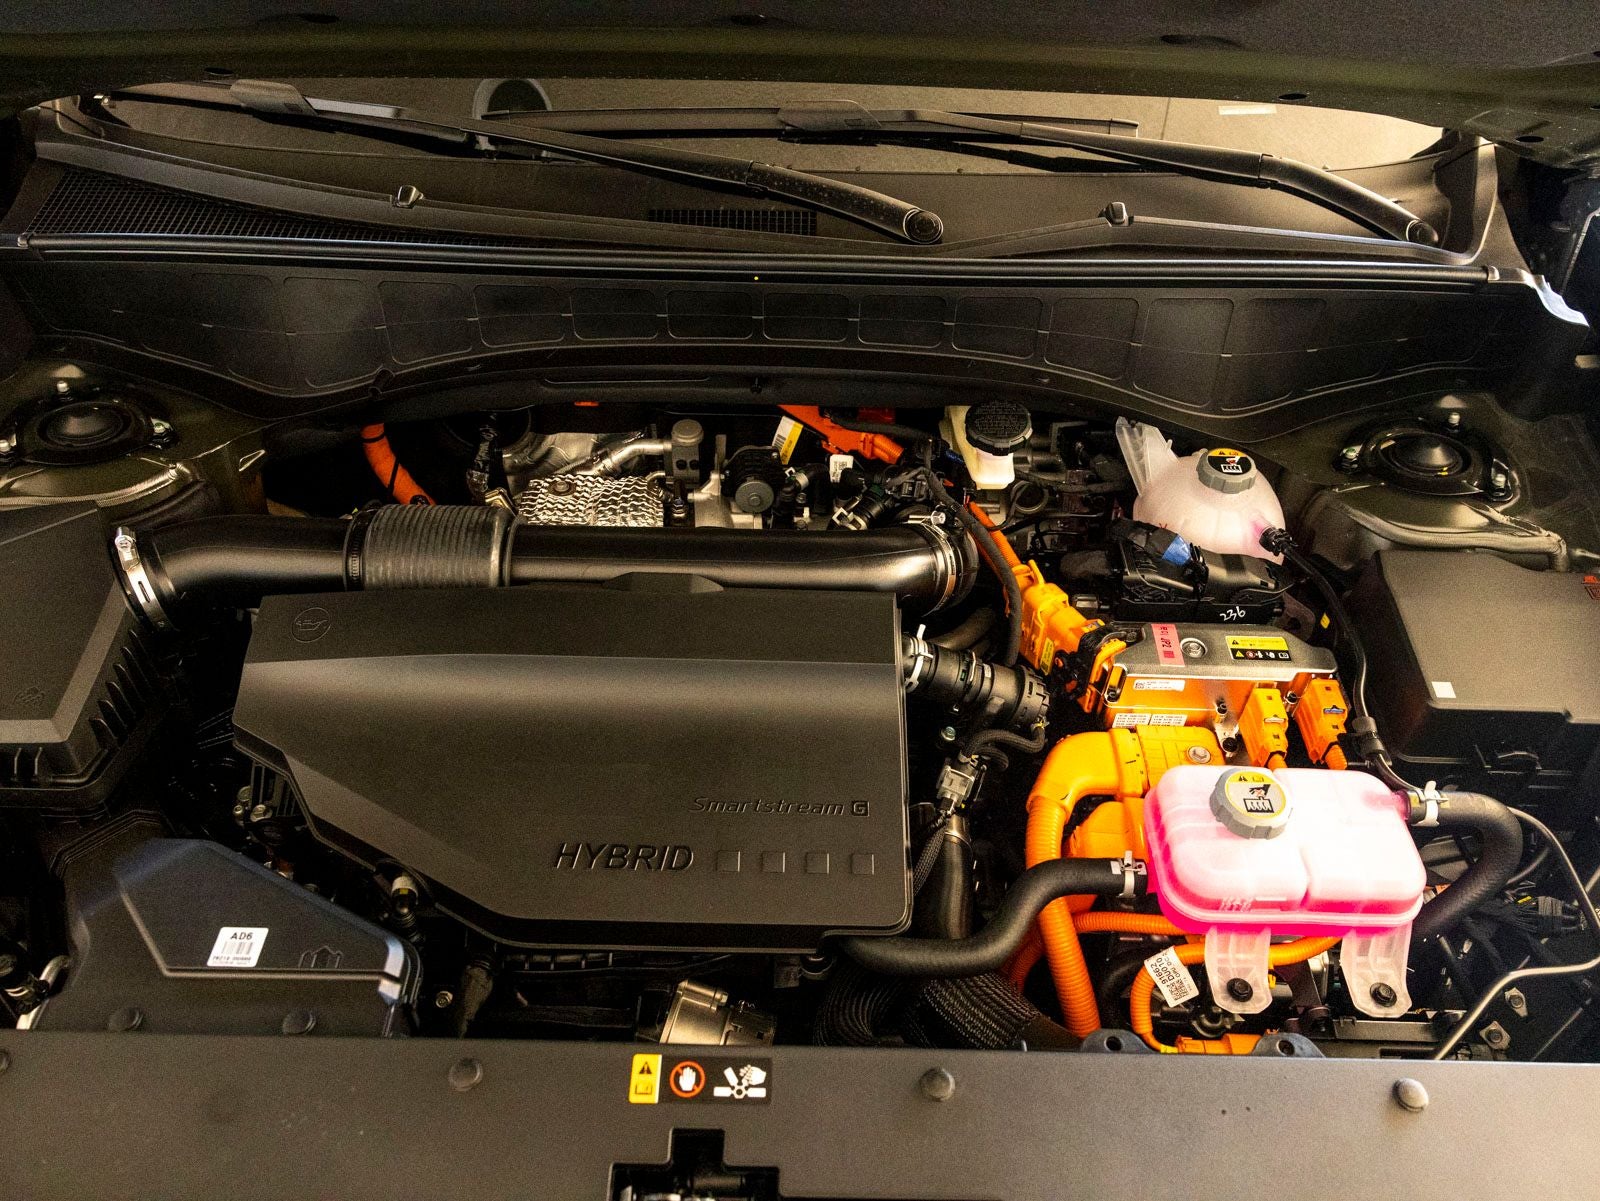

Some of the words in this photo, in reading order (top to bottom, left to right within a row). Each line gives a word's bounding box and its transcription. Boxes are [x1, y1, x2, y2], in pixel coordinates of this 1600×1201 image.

[1219, 605, 1246, 621] 236
[689, 797, 845, 816] Smartstream
[851, 801, 869, 816] G
[552, 842, 694, 871] HYBRID
[230, 931, 254, 940] AD6
[1150, 962, 1168, 985] 91662
[1156, 957, 1175, 982] DU010
